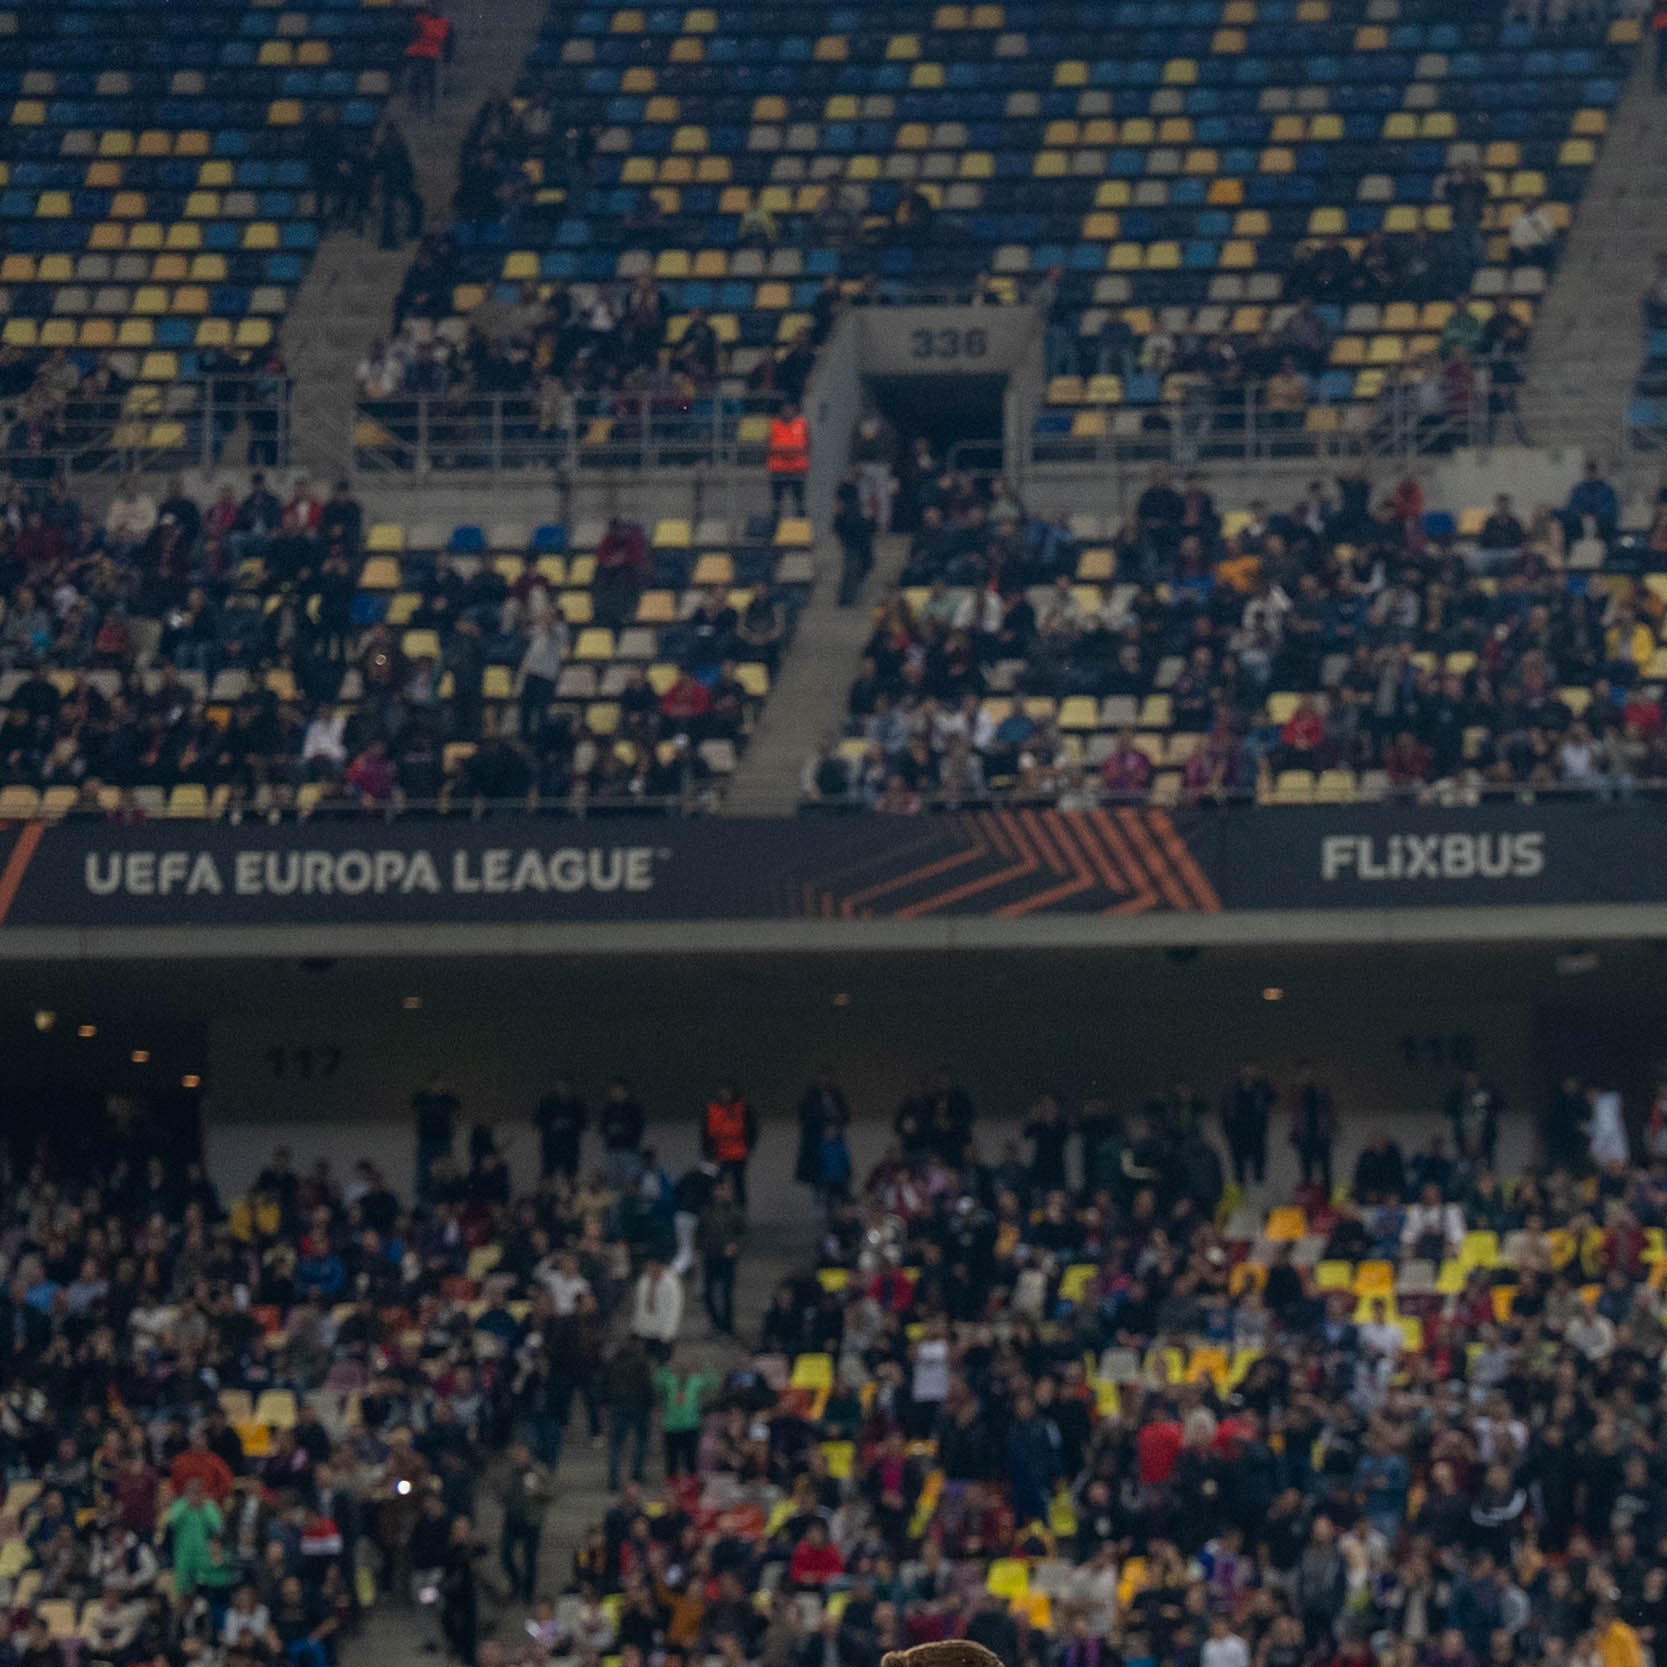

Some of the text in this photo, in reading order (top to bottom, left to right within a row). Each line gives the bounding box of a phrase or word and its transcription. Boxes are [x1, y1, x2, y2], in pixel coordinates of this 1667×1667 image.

[911, 328, 990, 358] 336
[84, 848, 655, 896] UEFA EUROPA LEAGUE
[265, 1046, 343, 1080] 117
